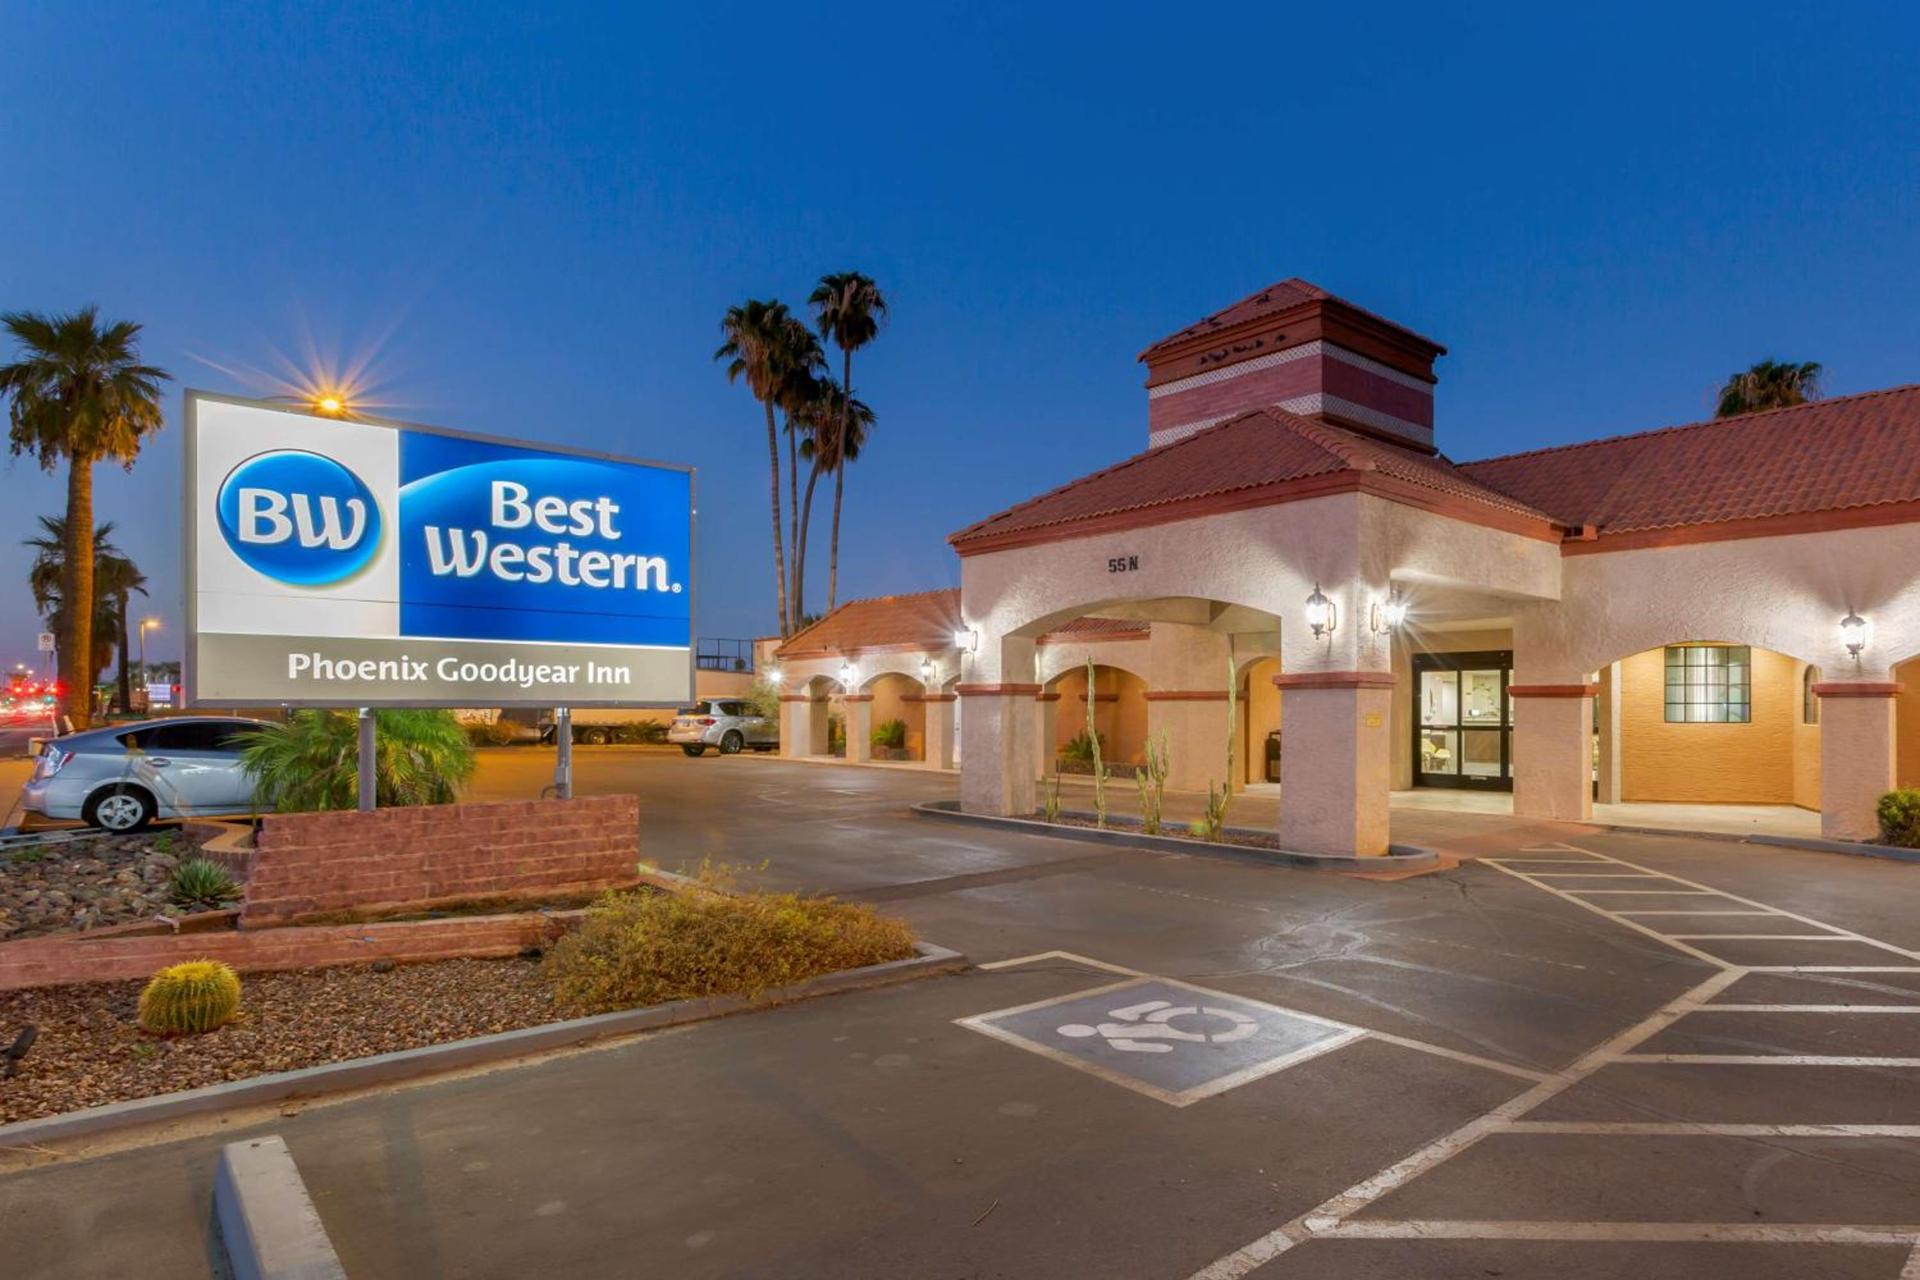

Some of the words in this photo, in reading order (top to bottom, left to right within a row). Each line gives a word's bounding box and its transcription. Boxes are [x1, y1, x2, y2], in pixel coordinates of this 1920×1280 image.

[238, 487, 366, 550] BW
[491, 480, 622, 540] Best
[1108, 558, 1126, 573] 55
[1129, 555, 1139, 571] N
[288, 652, 429, 681] Phoenix
[436, 657, 580, 688] Goodyear
[587, 661, 631, 684] Inn
